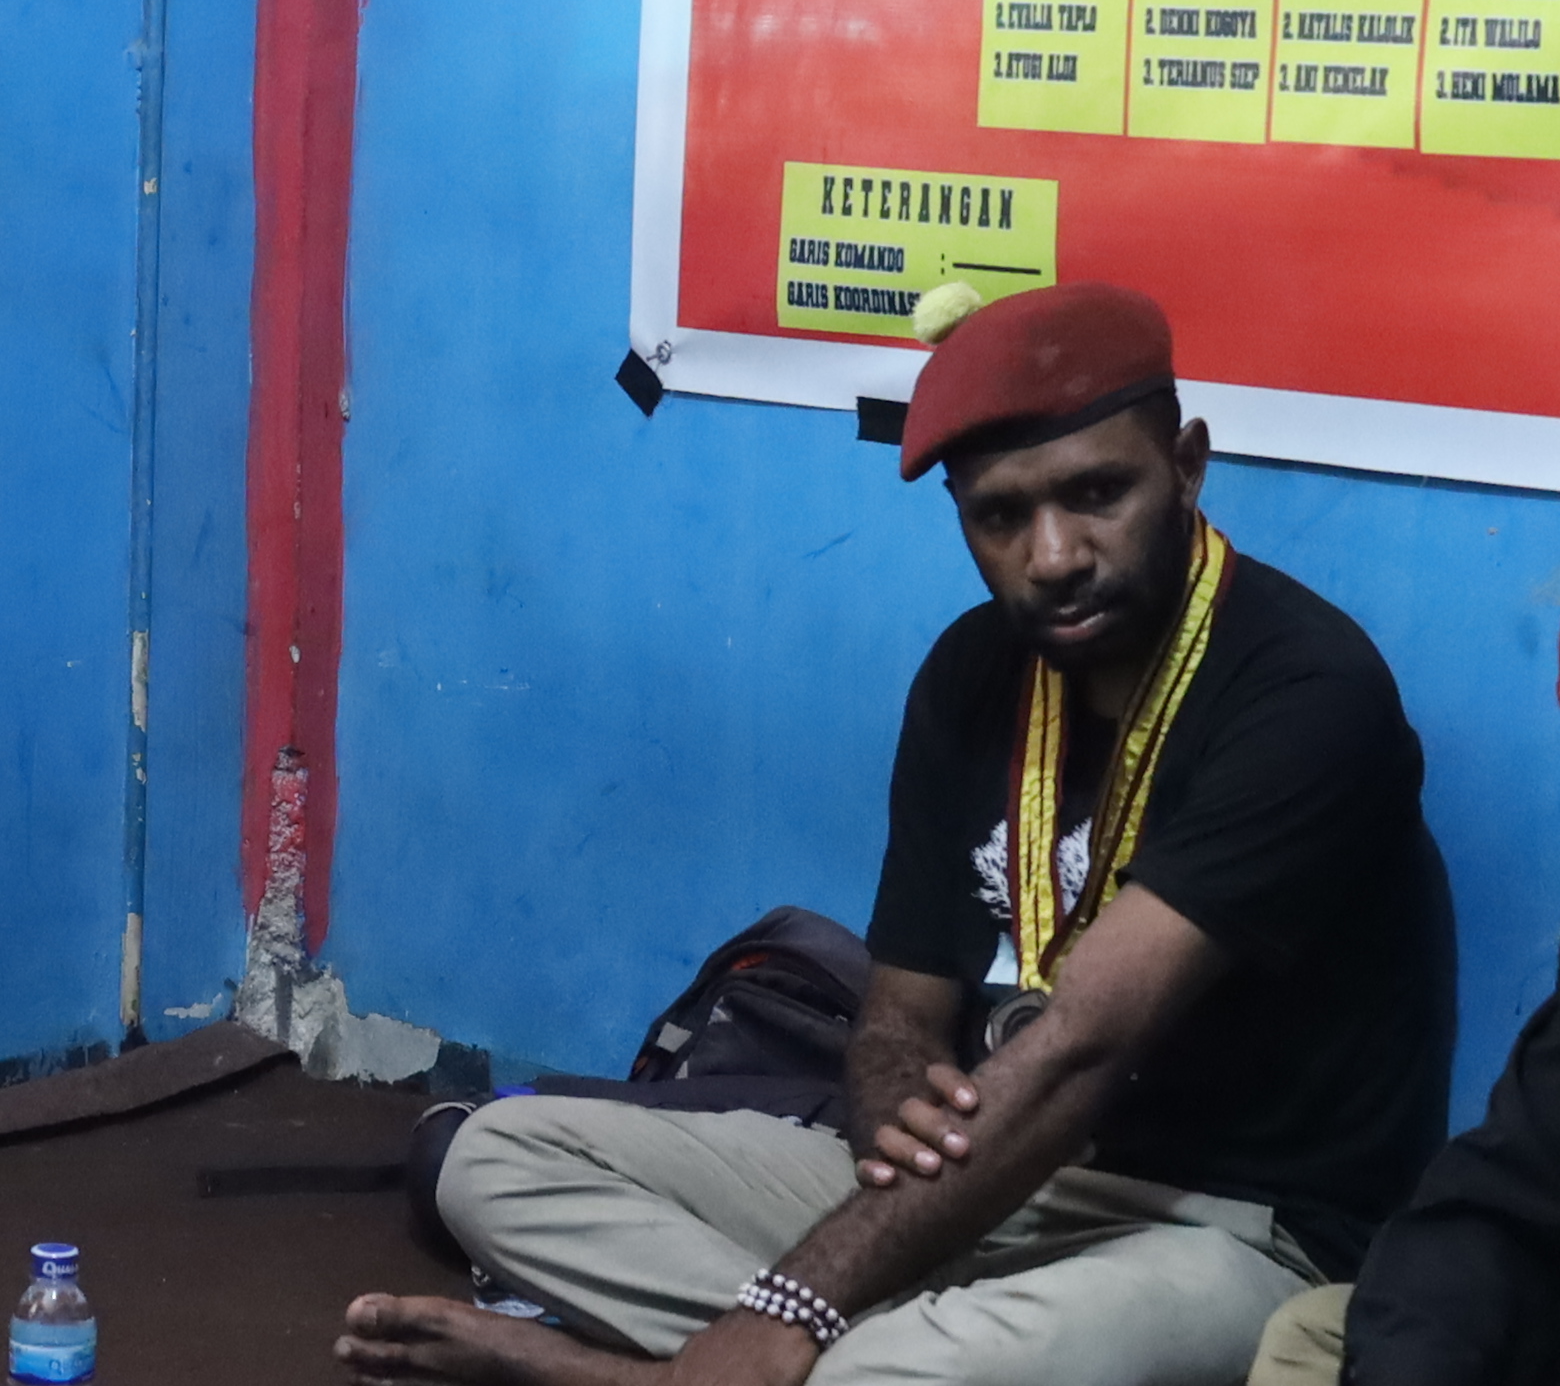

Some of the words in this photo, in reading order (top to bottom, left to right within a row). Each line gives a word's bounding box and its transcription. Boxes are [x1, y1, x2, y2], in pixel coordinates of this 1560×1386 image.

[822, 176, 1013, 229] KETERANGAN
[789, 238, 830, 266] GARIS
[834, 242, 904, 273] KOMANDO
[787, 281, 829, 309] GARIS
